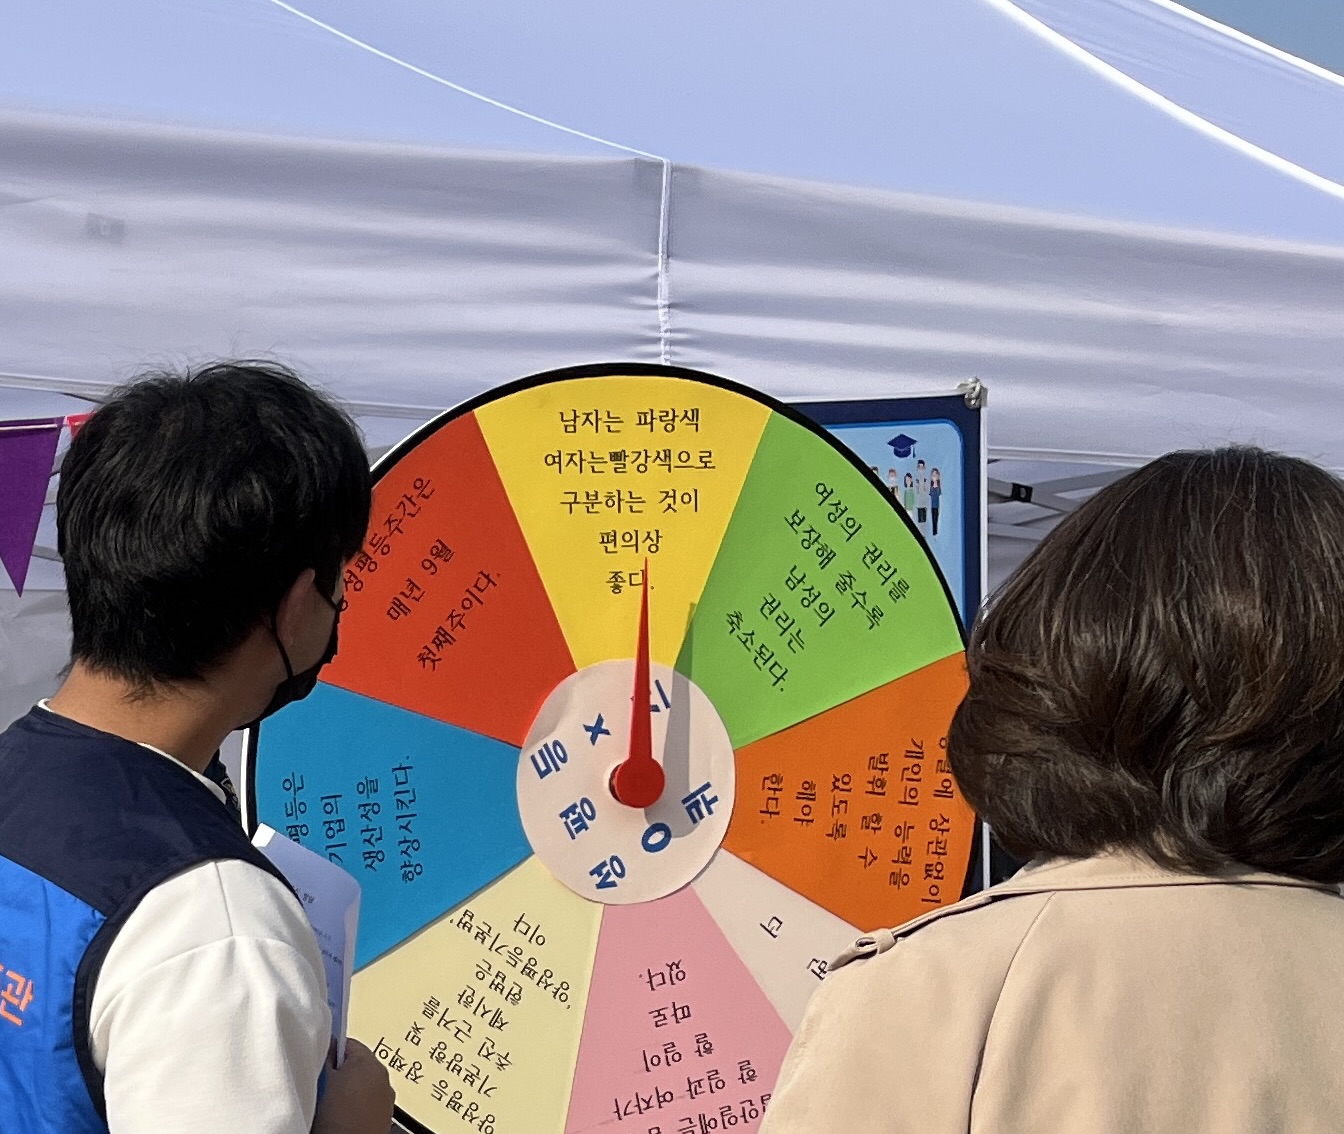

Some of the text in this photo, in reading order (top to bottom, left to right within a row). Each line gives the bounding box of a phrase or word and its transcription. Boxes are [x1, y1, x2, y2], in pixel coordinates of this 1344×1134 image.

[559, 408, 700, 434] 남자는 파랑색
[544, 449, 717, 474] 여자는빨강색으로
[559, 487, 699, 515] 구분하는 것이
[599, 529, 663, 554] 편의상
[783, 508, 885, 631] 보장해 줄수록
[815, 482, 911, 604] 여성의 권리를
[386, 538, 455, 622] 매년 9월
[784, 564, 836, 628] 남성의
[417, 569, 502, 672] 첫째주이다.
[725, 609, 789, 693] 축소된다.
[759, 592, 806, 654] 권리는
[320, 794, 348, 865] 기업의
[356, 775, 385, 872] 생산성을
[391, 755, 424, 884] 향상시킨다.
[759, 773, 784, 825] 한다.
[793, 780, 817, 827] 해야
[824, 773, 852, 841] 있도록
[857, 752, 890, 869] 발휘 할 수
[888, 737, 925, 890] 개인의 능력을
[920, 812, 951, 904] 상관없이
[513, 912, 547, 947] 이다
[475, 958, 524, 1006] 헌법은
[637, 959, 687, 992] 있다.
[422, 995, 513, 1072] 추진 근거를
[457, 984, 510, 1032] 제시한
[647, 1001, 692, 1028] 따로
[372, 1036, 425, 1085] 정책의
[404, 1021, 498, 1098] 기본방향 및
[642, 1032, 715, 1073] 할 일이
[612, 1059, 759, 1121] 할 일과 여자가
